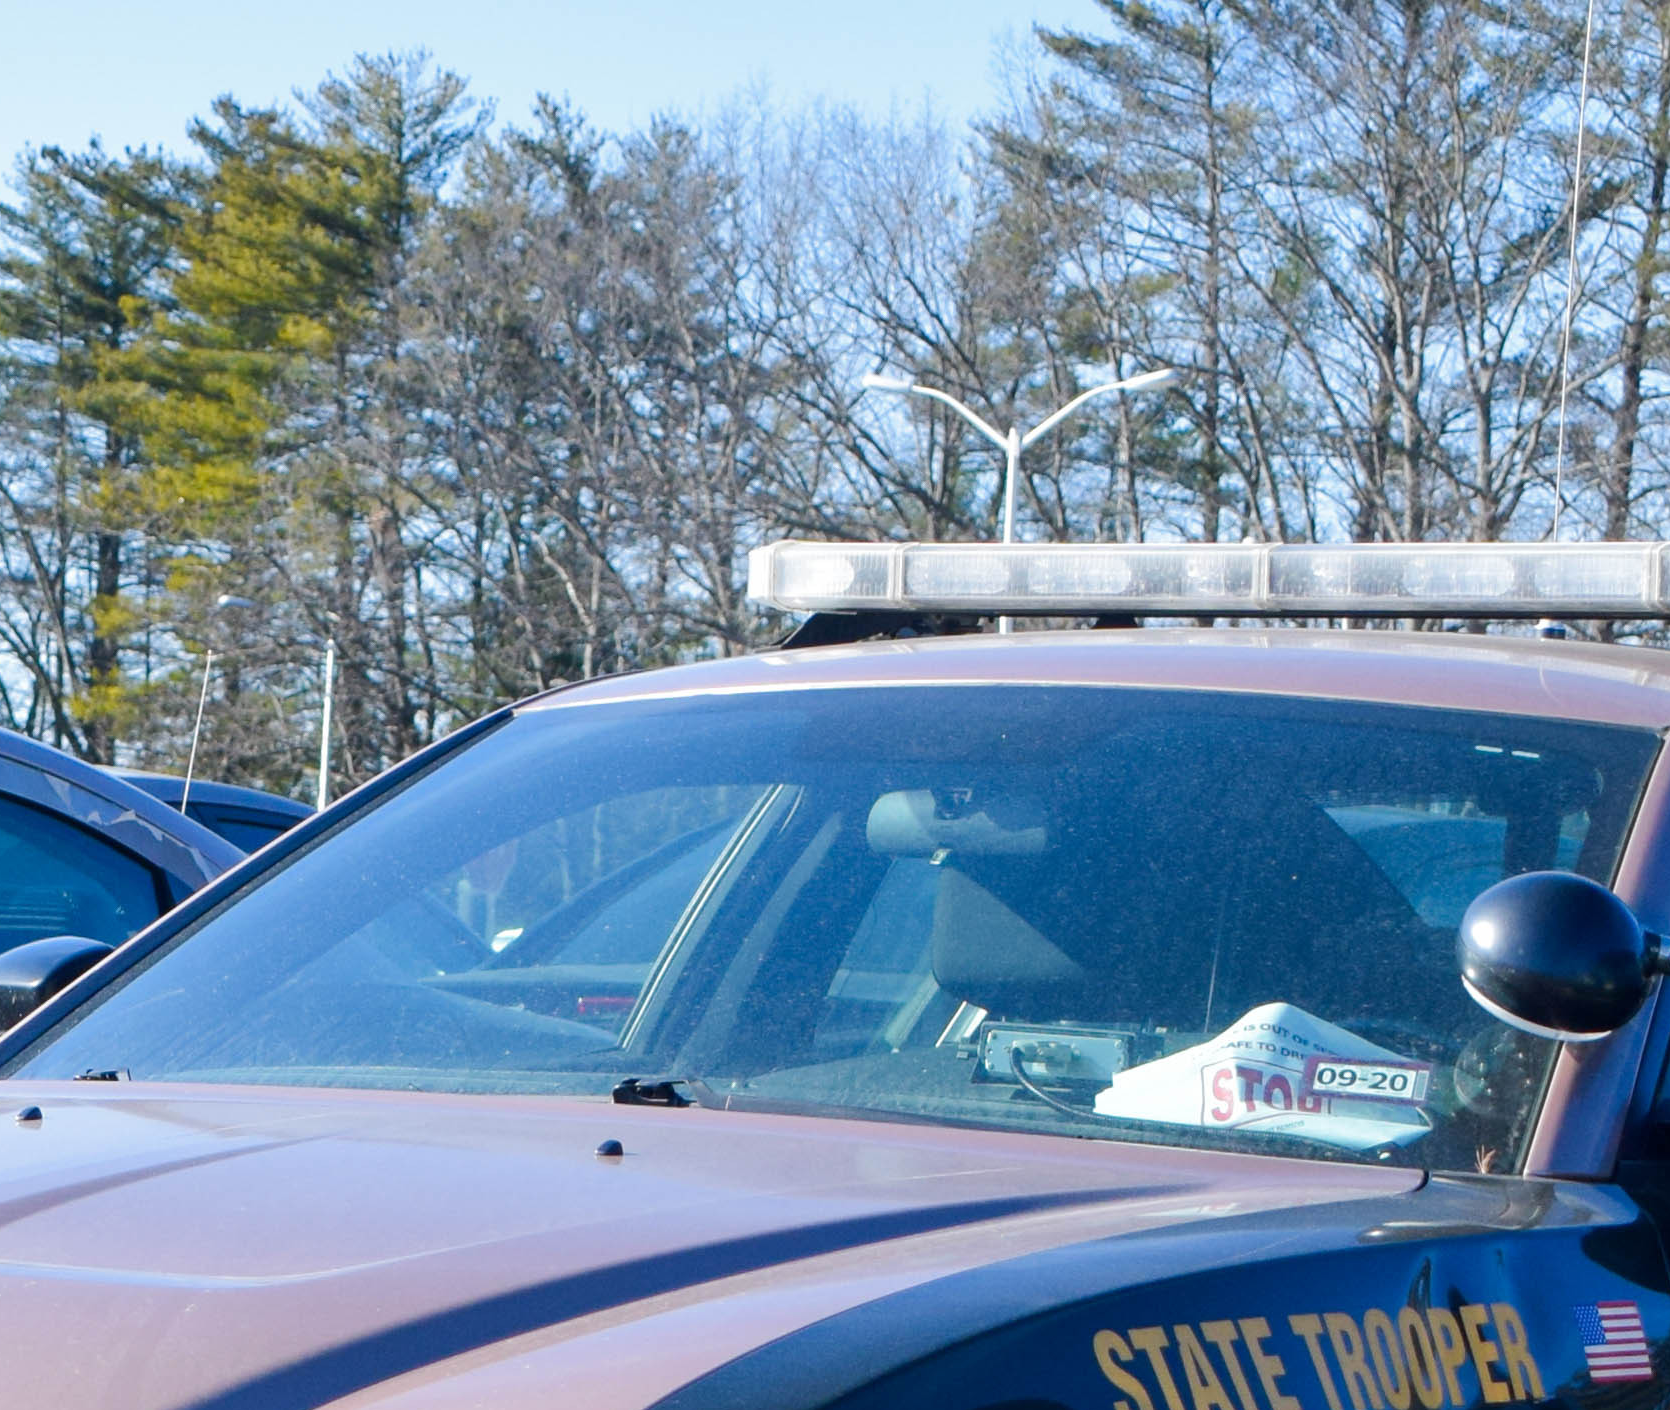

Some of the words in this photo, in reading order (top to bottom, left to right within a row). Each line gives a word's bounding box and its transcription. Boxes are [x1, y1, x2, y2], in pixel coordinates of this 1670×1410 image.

[1259, 1022, 1290, 1039] OUT
[1221, 1040, 1253, 1050] AFE
[1257, 1041, 1276, 1052] TO
[1316, 1067, 1408, 1092] 09-20
